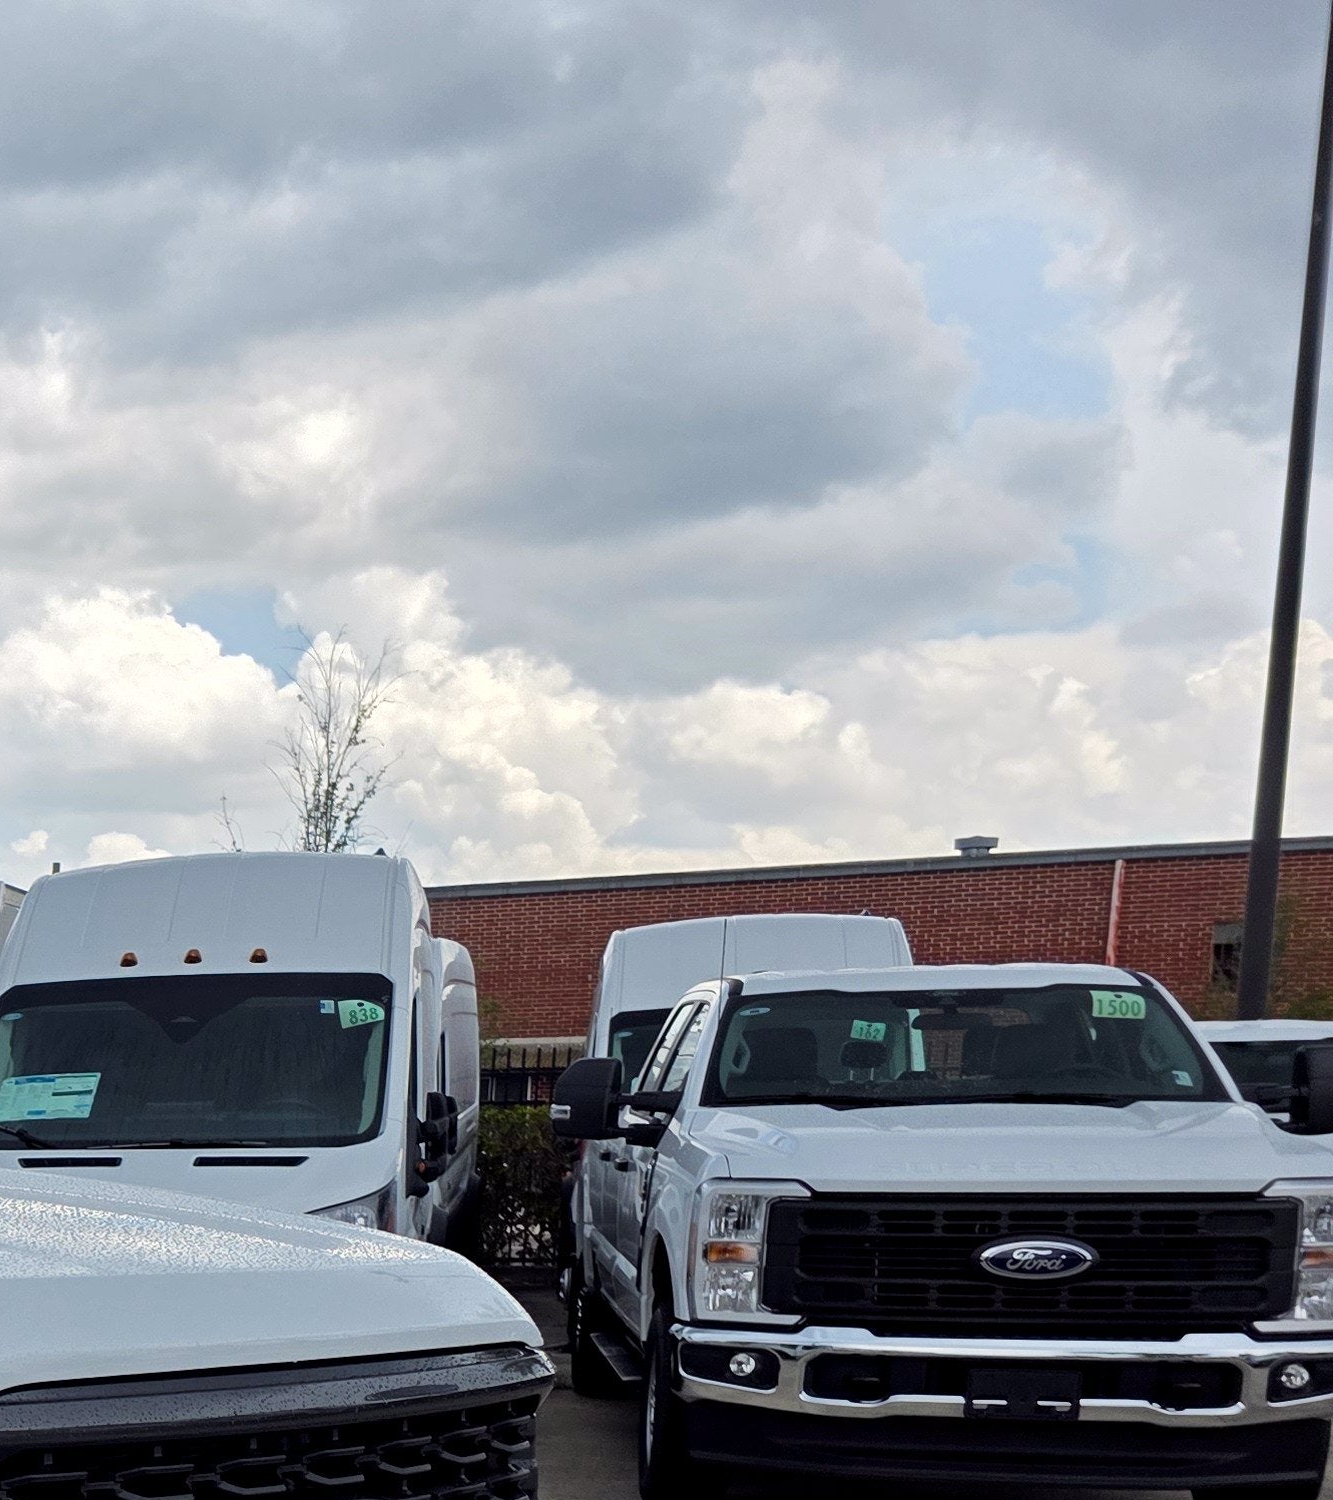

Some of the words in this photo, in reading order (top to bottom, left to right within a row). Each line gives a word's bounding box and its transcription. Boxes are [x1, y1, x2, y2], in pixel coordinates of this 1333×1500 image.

[349, 1007, 379, 1025] 838
[1097, 999, 1142, 1017] 1500
[1006, 1248, 1067, 1271] Ford
